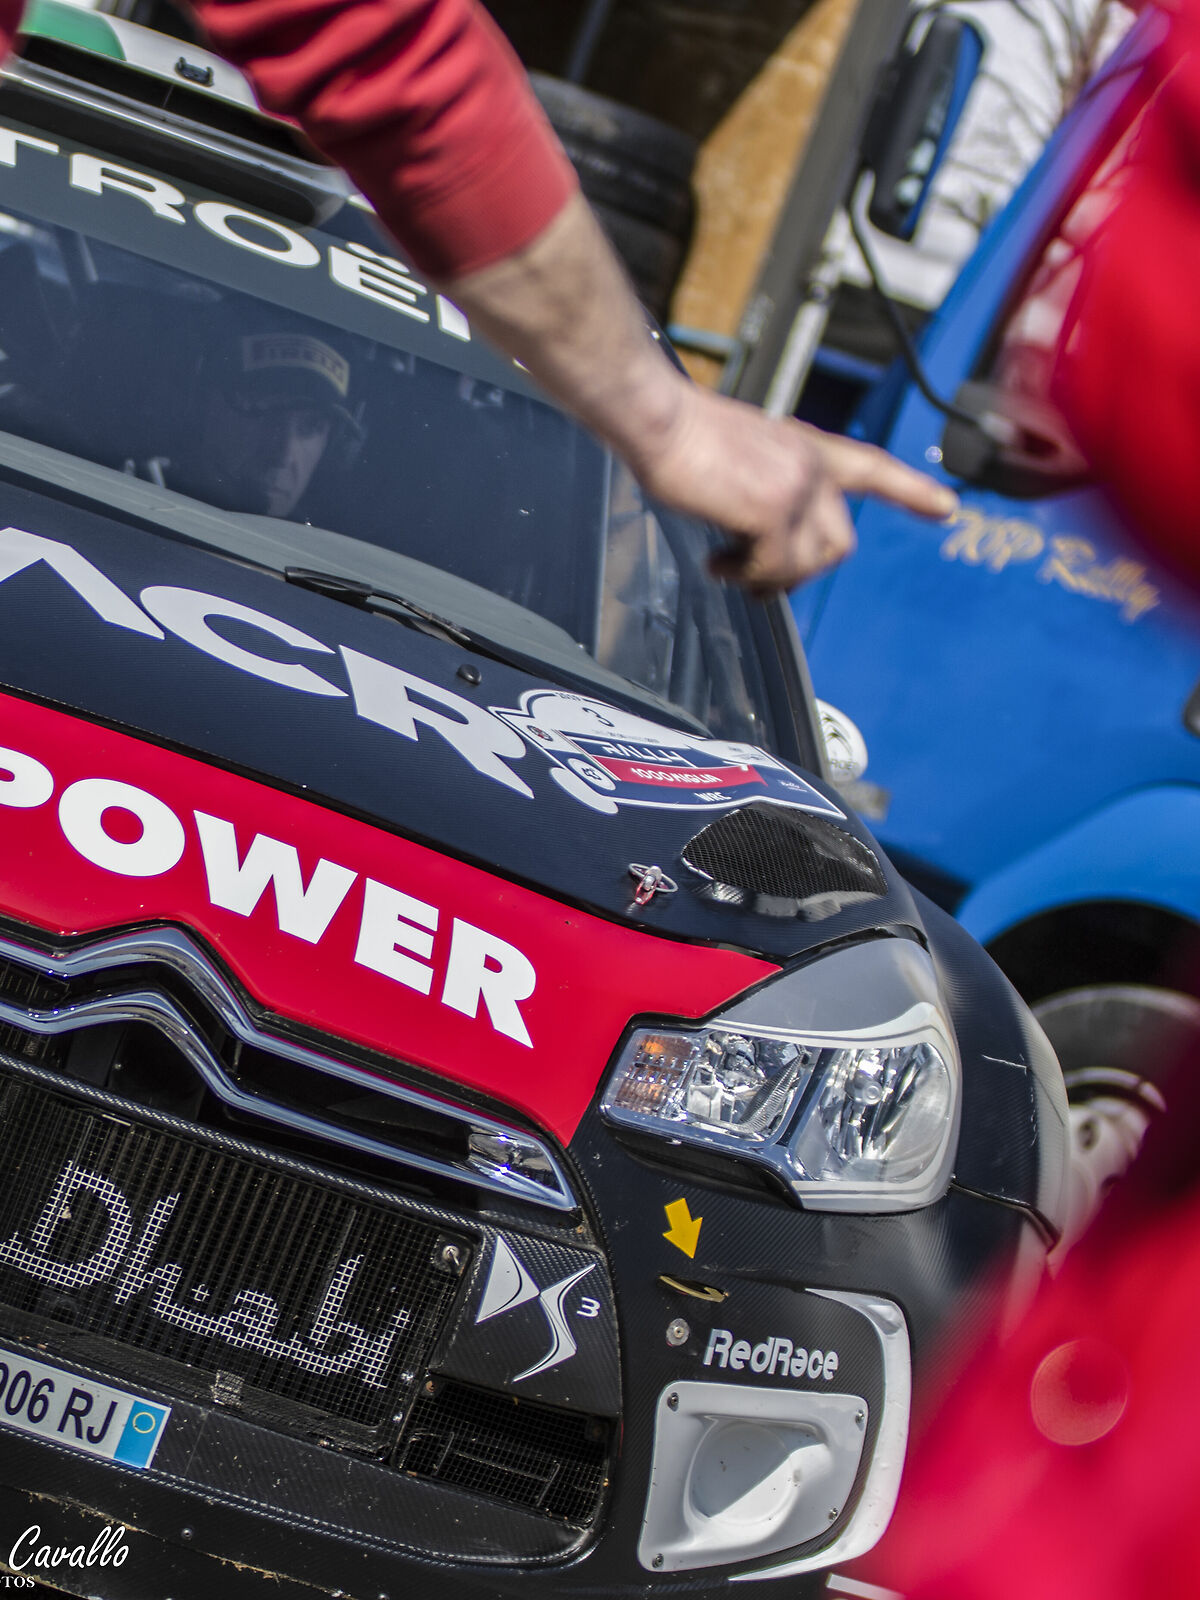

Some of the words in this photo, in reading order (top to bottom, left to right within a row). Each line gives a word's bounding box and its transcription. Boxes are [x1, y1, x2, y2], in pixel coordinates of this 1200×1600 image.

[582, 707, 615, 727] 3
[695, 791, 733, 803] WRC
[703, 1328, 840, 1380] RedRace
[57, 1387, 118, 1444] RJ
